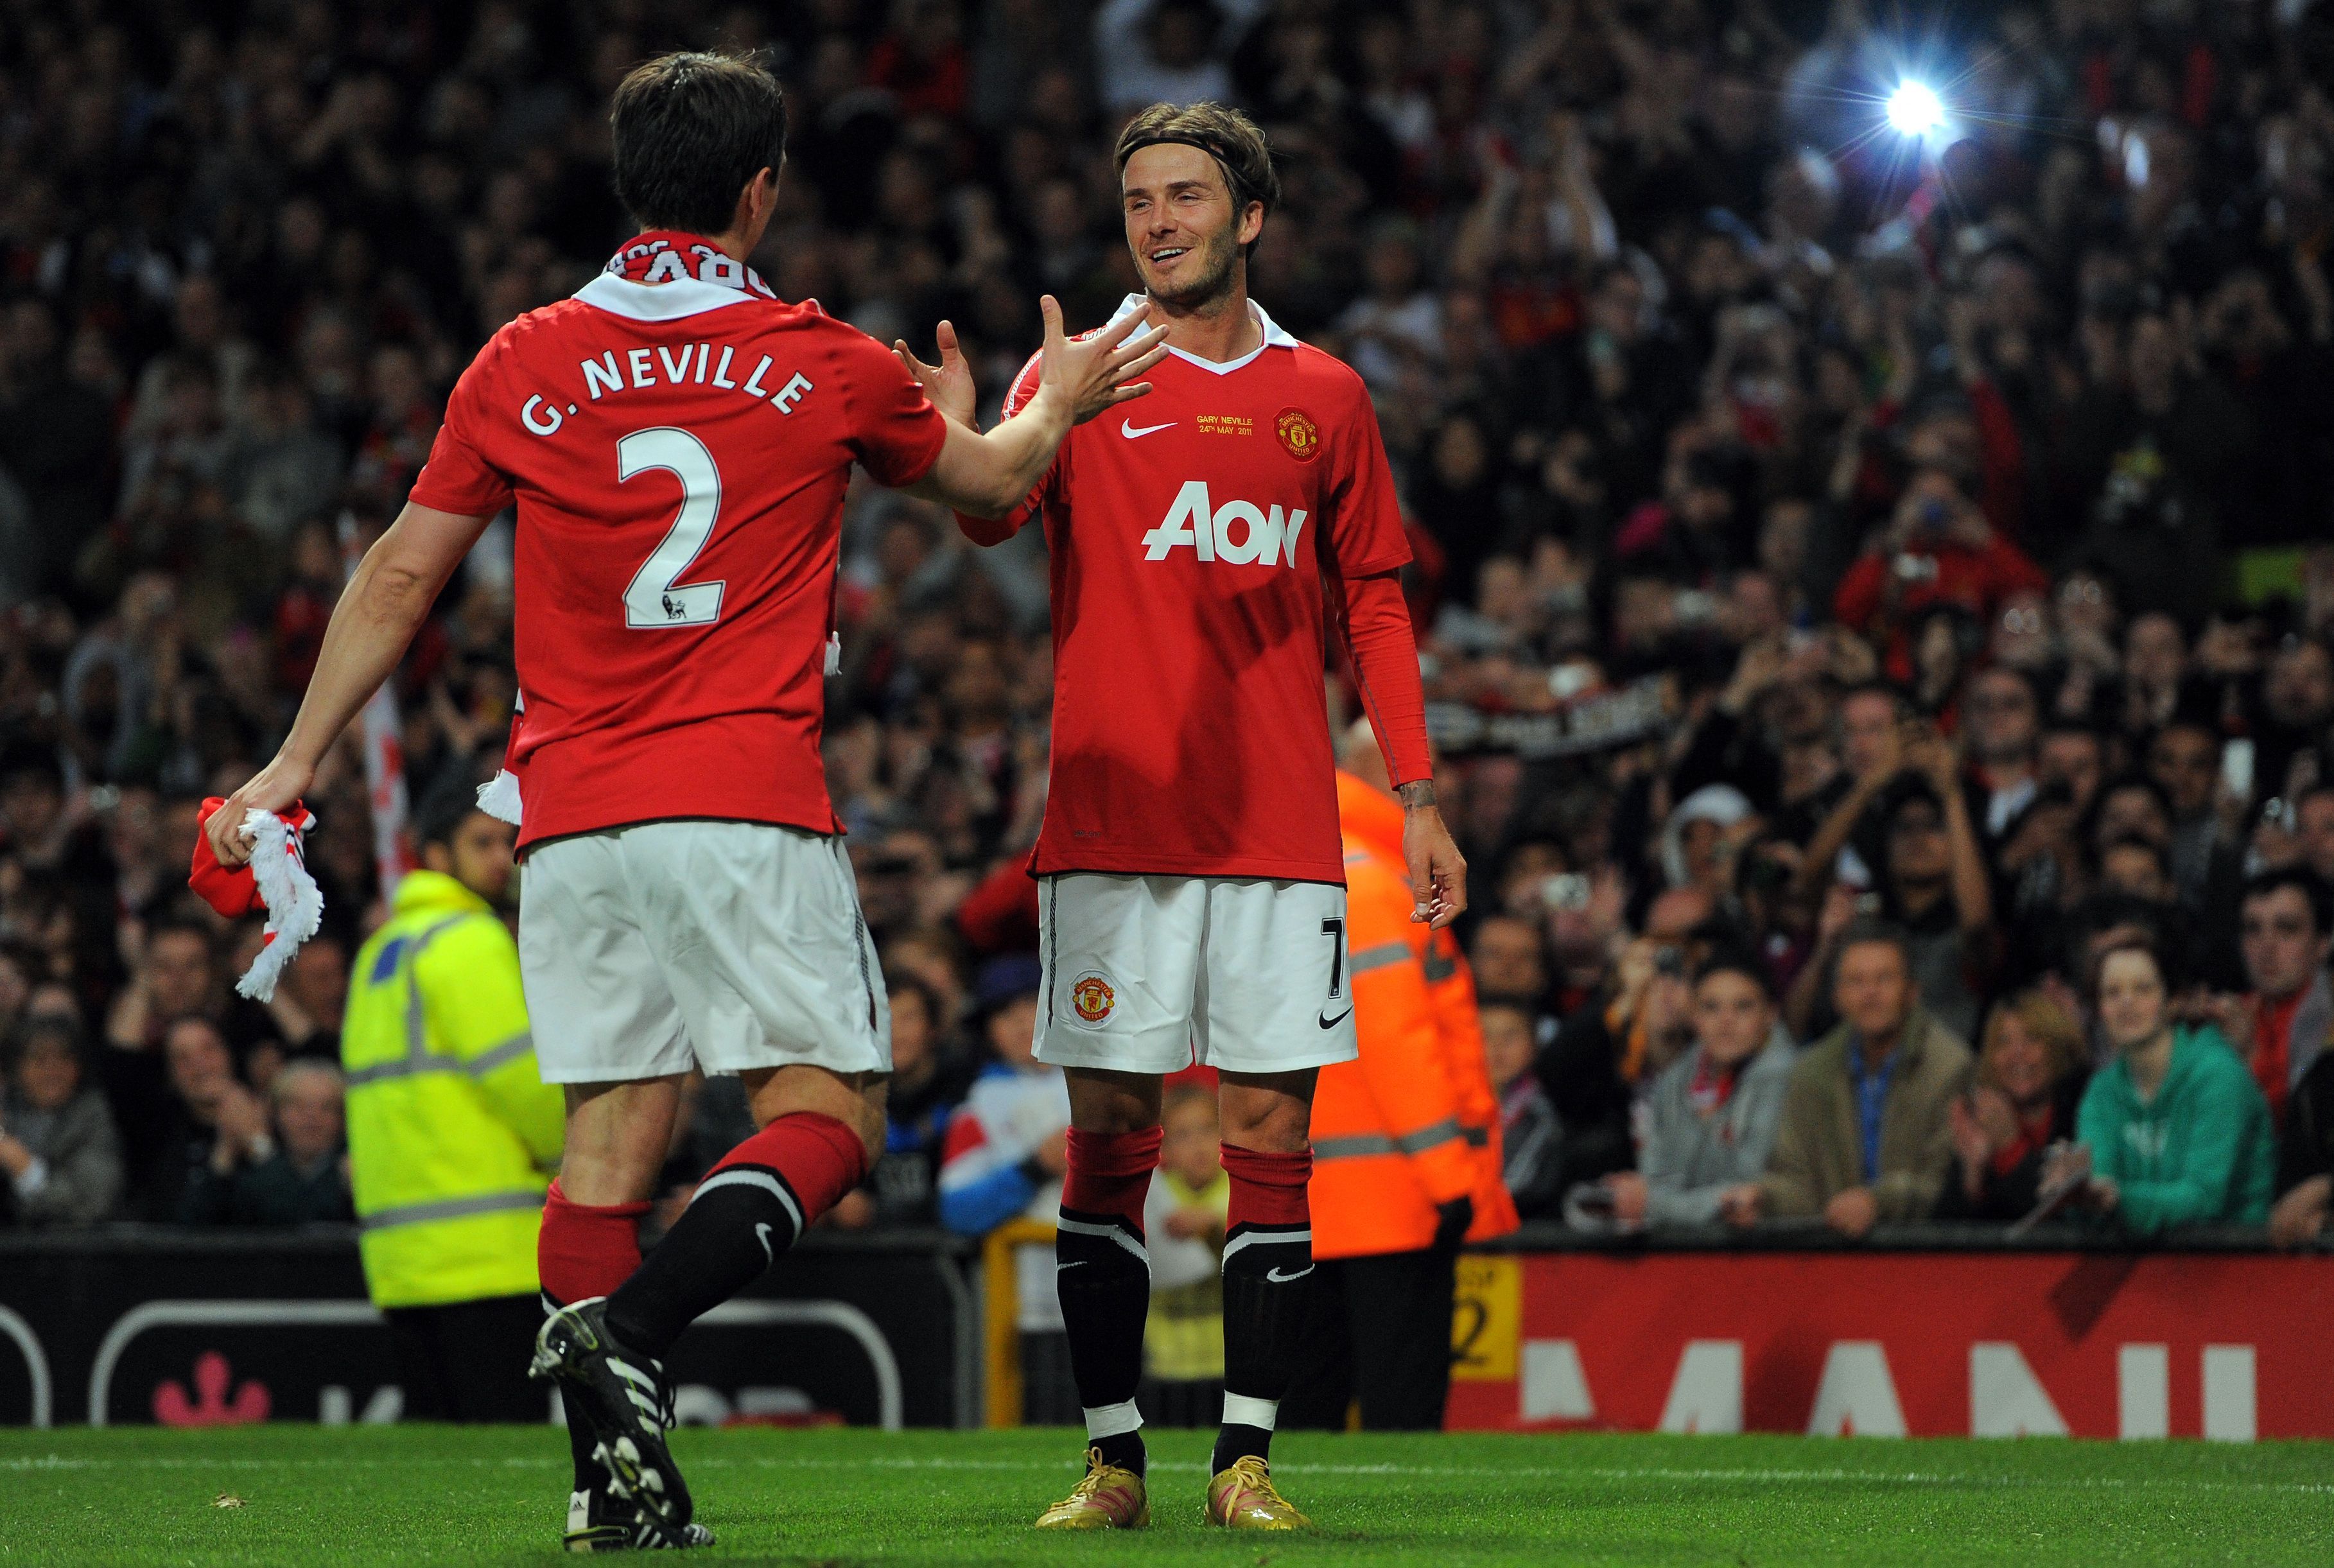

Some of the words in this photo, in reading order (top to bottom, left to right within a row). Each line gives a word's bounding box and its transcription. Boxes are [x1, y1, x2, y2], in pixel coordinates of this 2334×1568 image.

[521, 393, 577, 437] G.
[580, 343, 814, 415] NEVILLE
[1196, 415, 1219, 424] GARY
[1221, 416, 1253, 425] NEVILLE
[1217, 426, 1233, 435] MAY
[1237, 427, 1252, 436] 2011
[617, 426, 726, 629] 2
[1141, 480, 1308, 569] AON
[1321, 917, 1345, 999] 7
